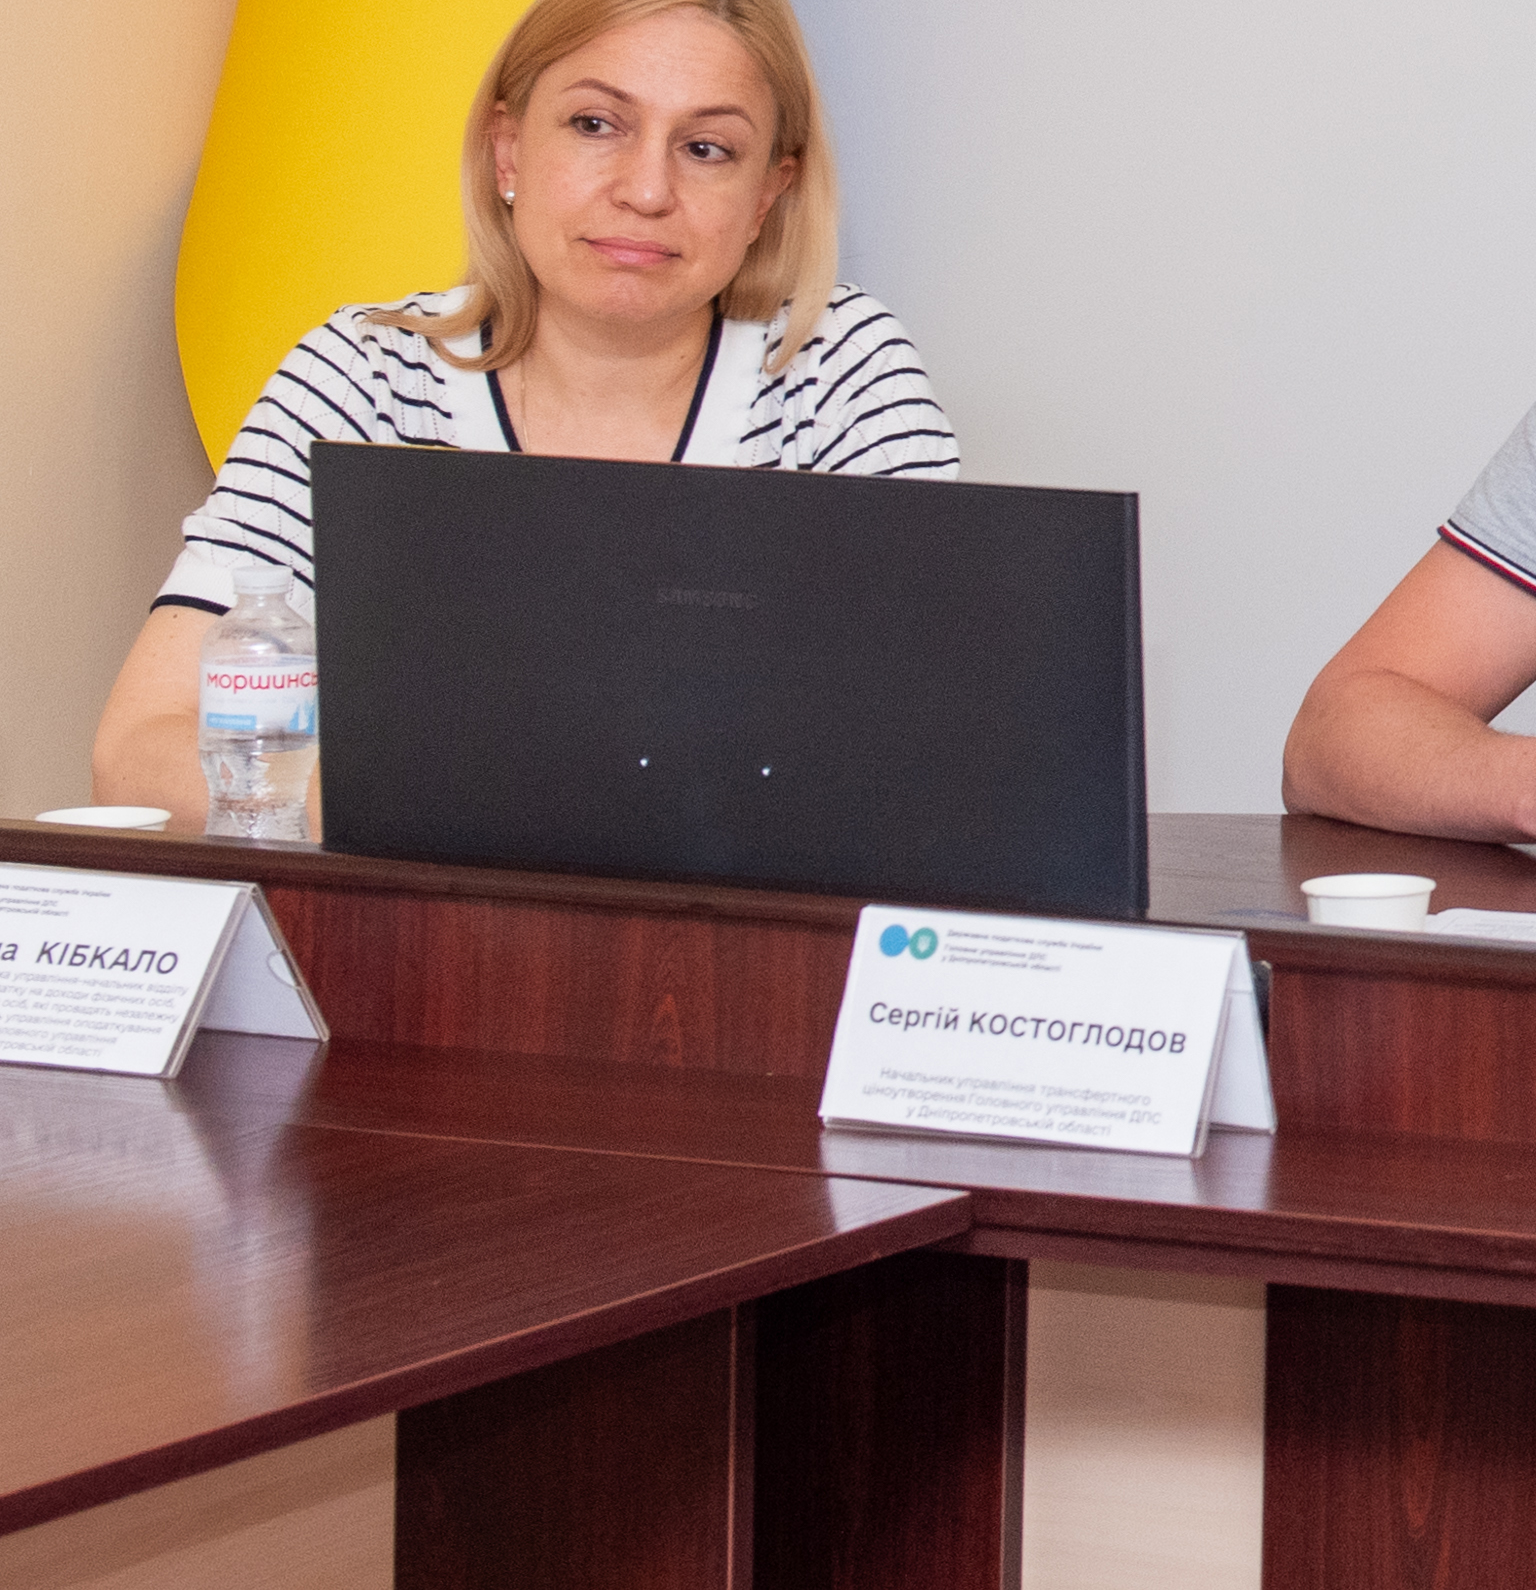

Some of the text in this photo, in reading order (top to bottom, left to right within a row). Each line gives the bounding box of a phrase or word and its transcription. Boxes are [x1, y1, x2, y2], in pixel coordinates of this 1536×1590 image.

[35, 940, 180, 976] КІБКАЛО
[868, 1001, 1188, 1055] Сергій КОСТОГЛОДОВ
